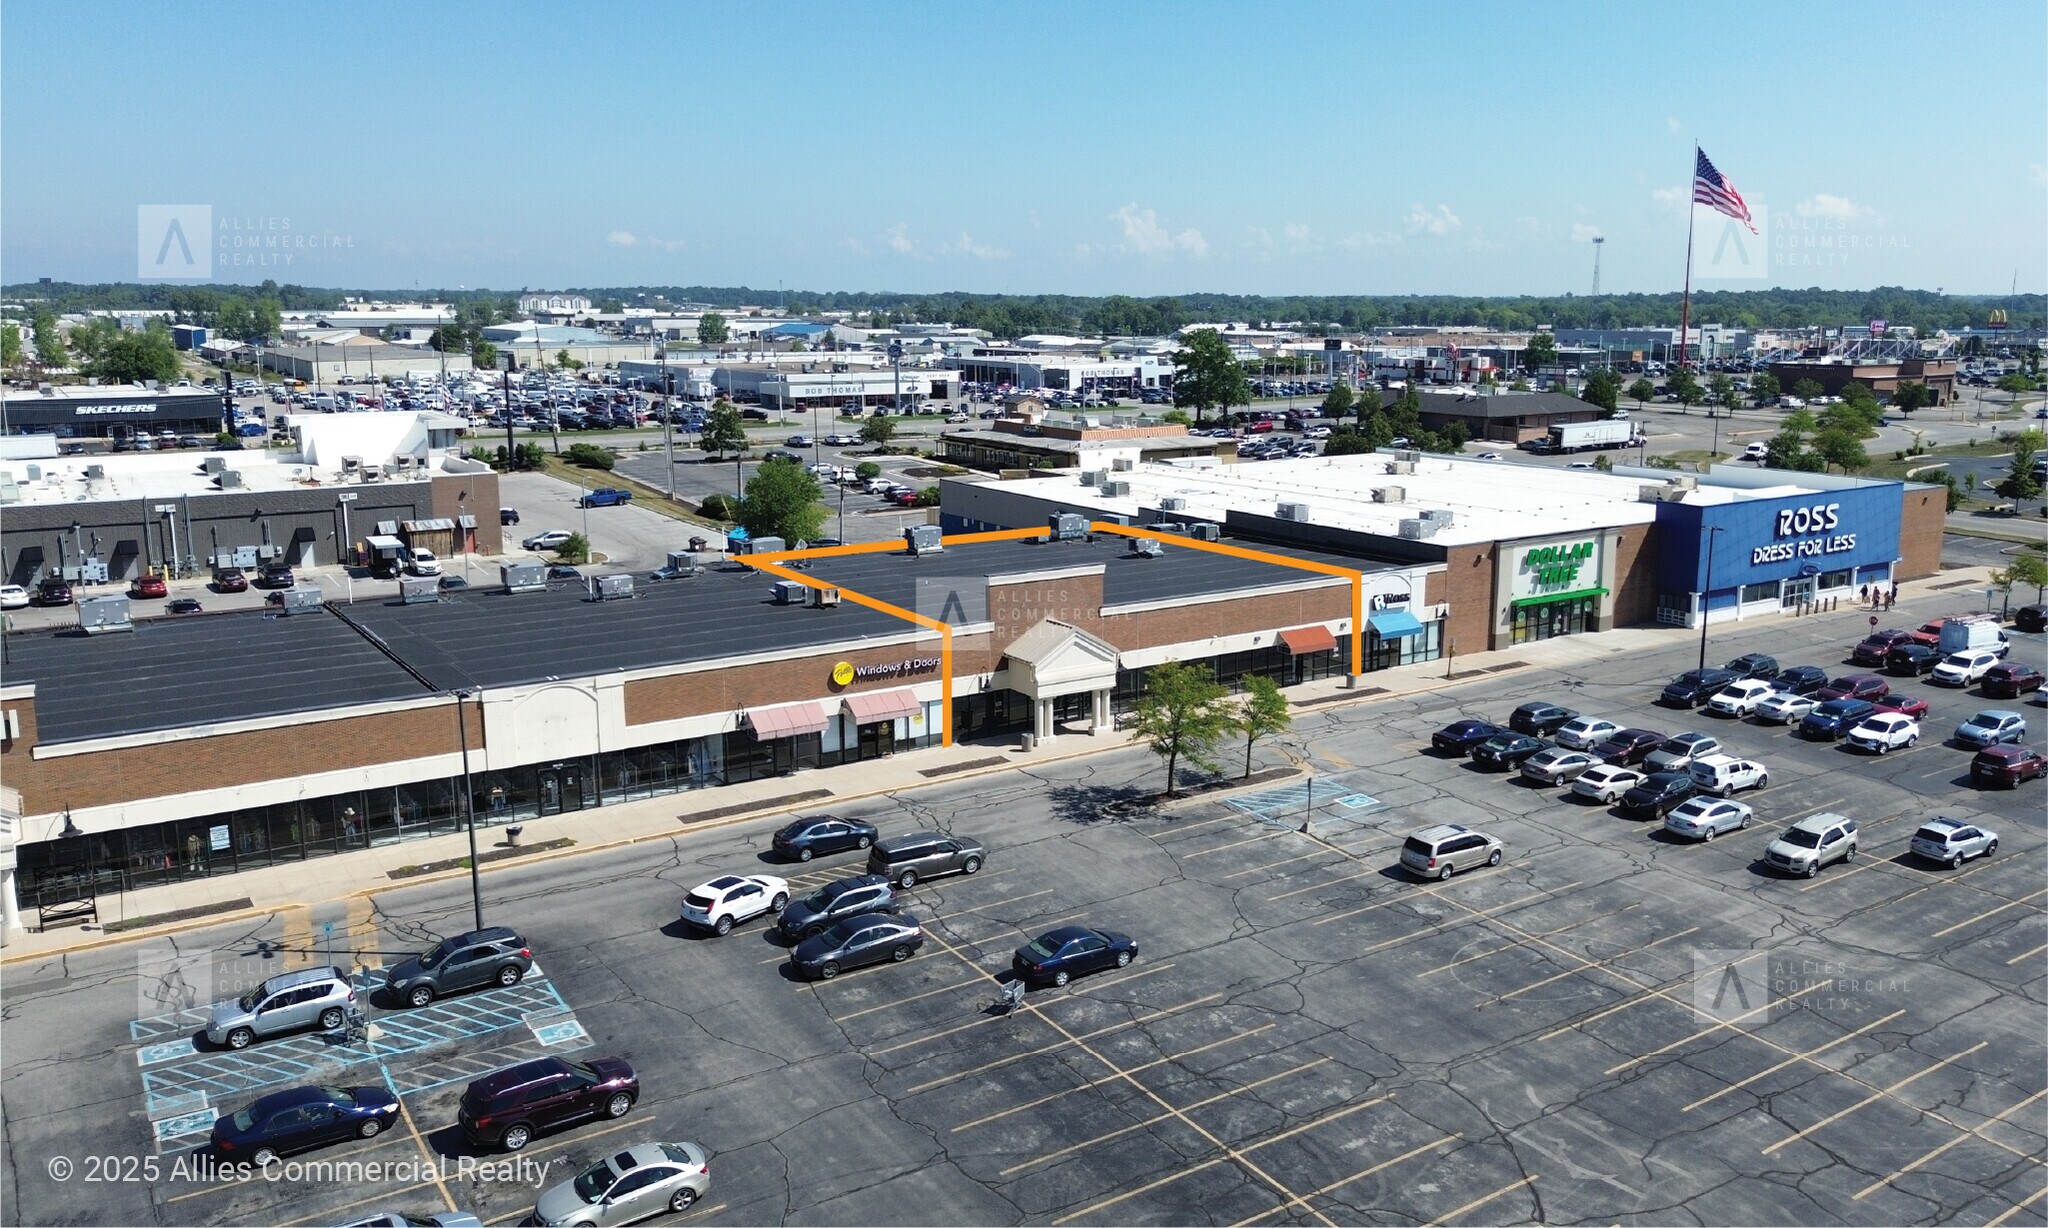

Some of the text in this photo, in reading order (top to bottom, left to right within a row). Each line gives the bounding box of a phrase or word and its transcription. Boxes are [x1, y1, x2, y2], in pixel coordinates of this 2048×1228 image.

[827, 386, 863, 394] THOMAS
[75, 404, 157, 415] SKECHERS
[1779, 503, 1840, 536] ROSS
[1526, 542, 1594, 566] DOLLAR
[1753, 533, 1857, 564] DRESS FOR LESS
[1538, 563, 1580, 585] TREE
[856, 661, 902, 677] Windows
[905, 659, 912, 670] &
[913, 656, 942, 669] Doors
